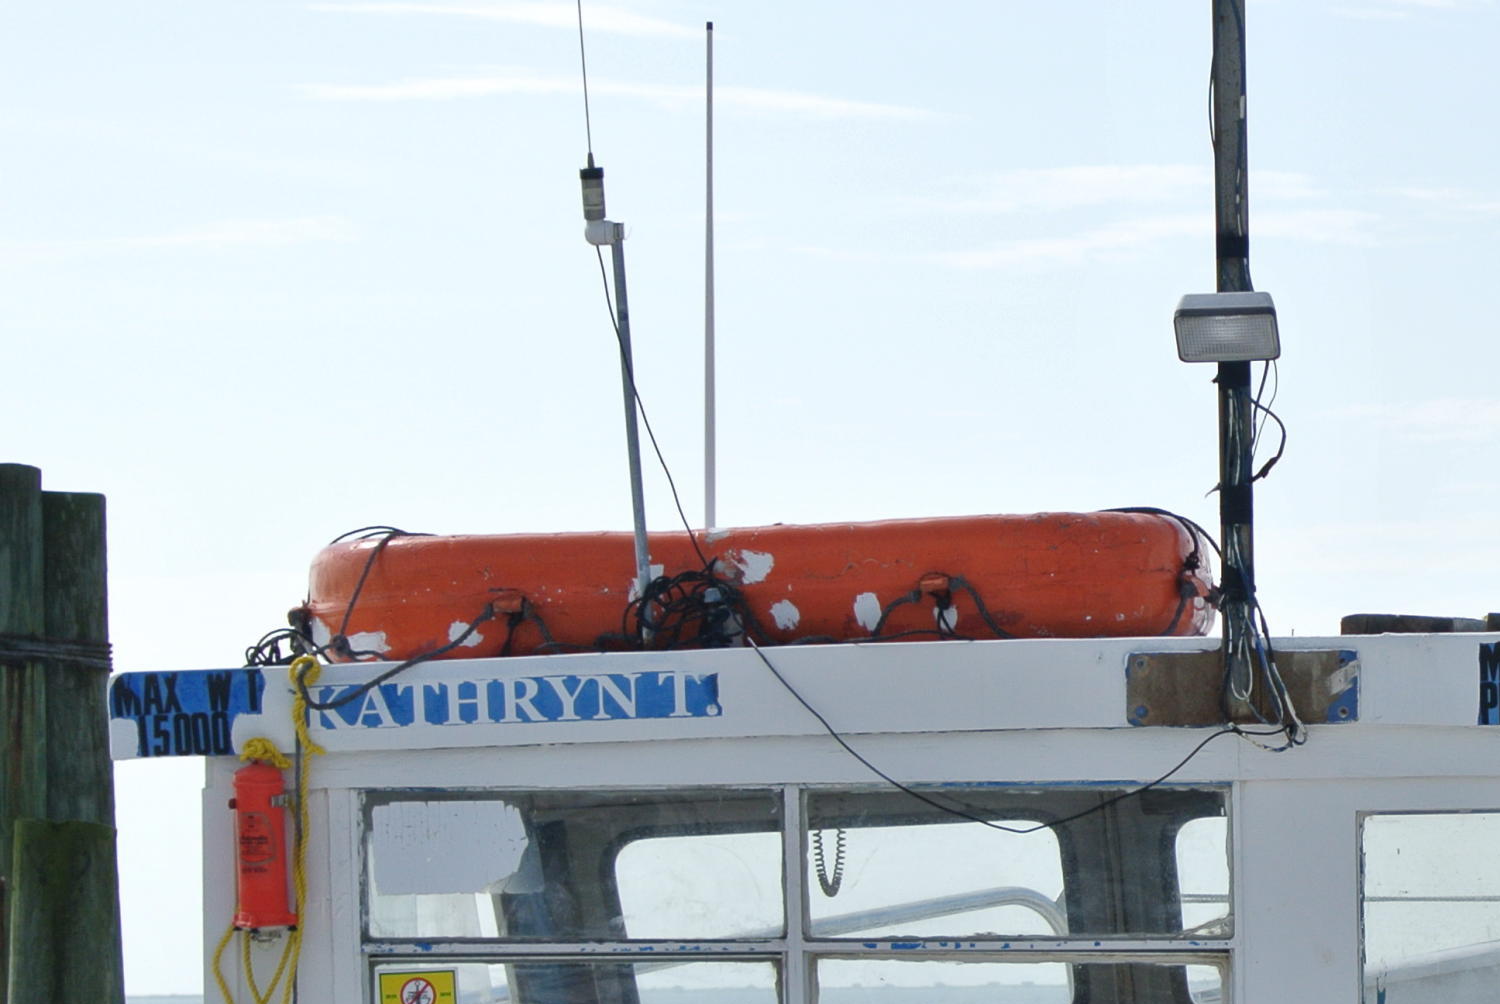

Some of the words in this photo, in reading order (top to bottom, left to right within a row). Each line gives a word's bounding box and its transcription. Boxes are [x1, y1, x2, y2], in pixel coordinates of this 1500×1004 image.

[114, 672, 182, 716] MAX
[306, 673, 642, 729] KATHRYN
[138, 712, 230, 757] 15000
